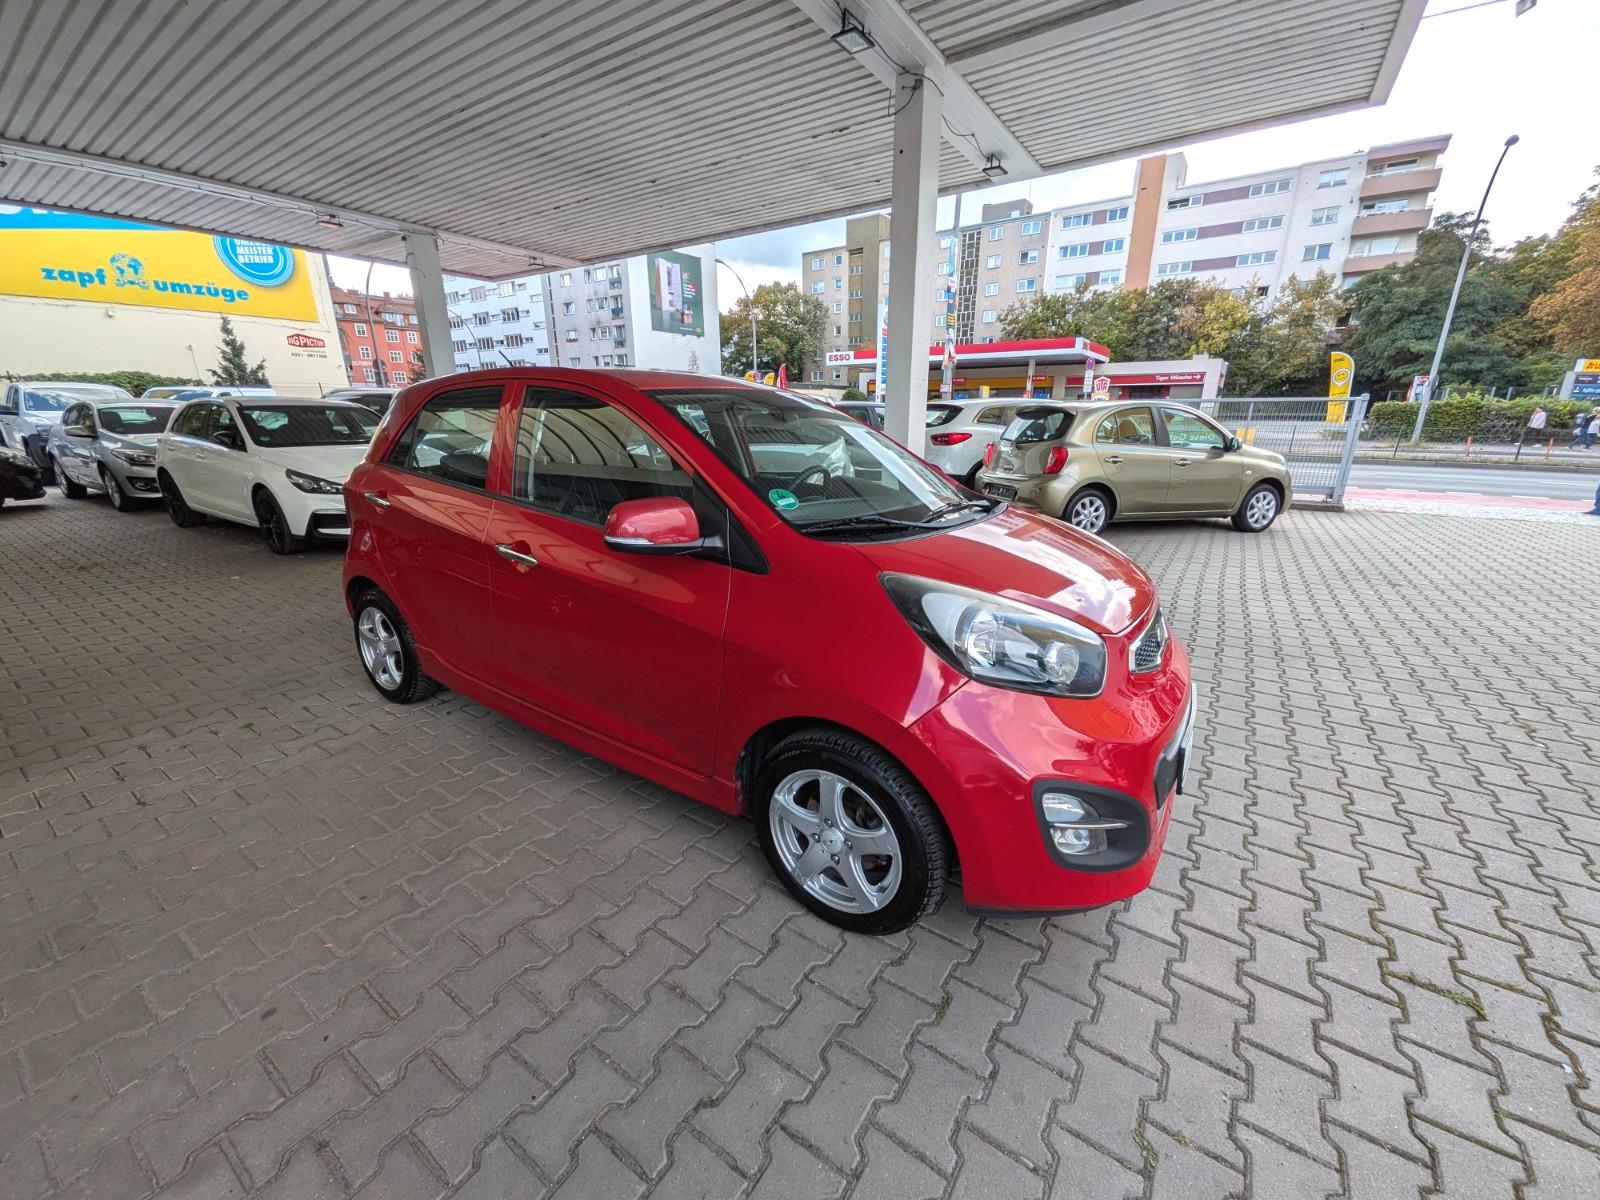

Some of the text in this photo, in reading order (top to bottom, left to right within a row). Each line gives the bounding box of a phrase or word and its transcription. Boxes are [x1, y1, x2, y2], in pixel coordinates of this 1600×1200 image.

[237, 245, 273, 255] MEISTER
[239, 254, 274, 264] BETRIEB
[41, 267, 250, 303] zapf umzüge
[828, 353, 851, 362] ESSO
[1096, 378, 1109, 391] UTA
